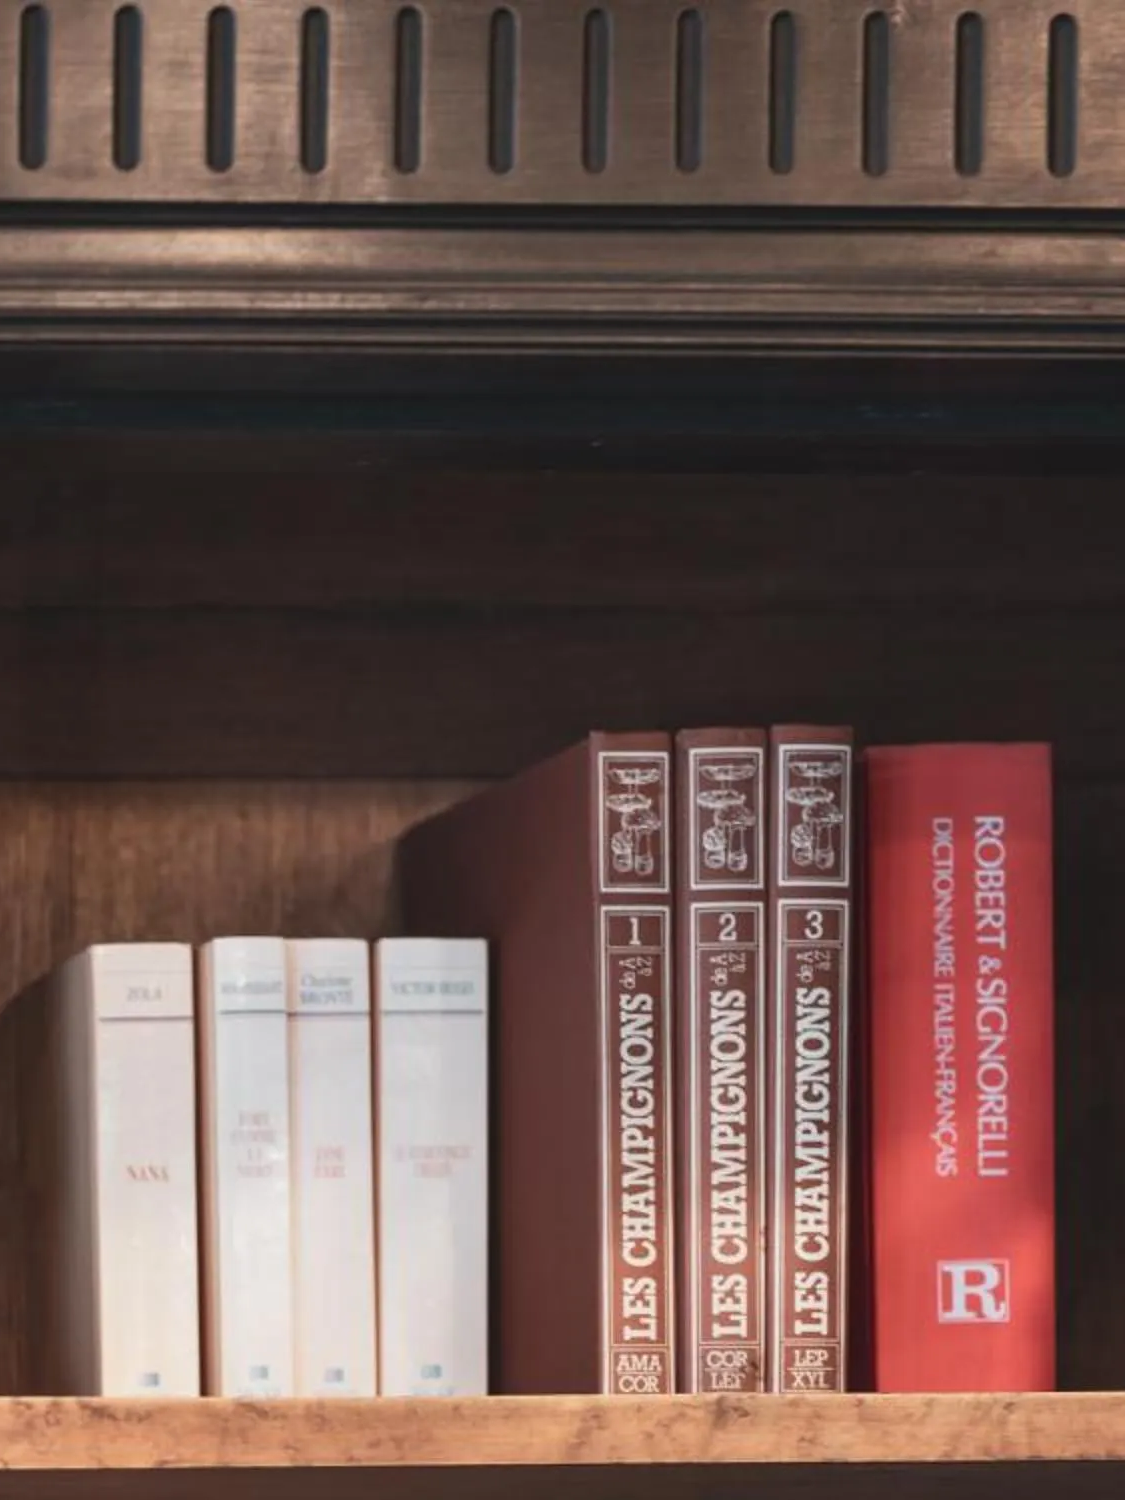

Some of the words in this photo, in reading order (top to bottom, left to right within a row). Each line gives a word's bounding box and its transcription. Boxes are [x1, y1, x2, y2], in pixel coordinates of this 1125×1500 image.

[932, 817, 955, 977] DICTIONNAIRE
[974, 815, 1006, 950] ROBERT
[629, 917, 641, 945] 1
[718, 913, 737, 941] 2
[804, 910, 824, 939] 3
[978, 955, 1002, 974] &
[930, 983, 958, 1177] ITALIEN-FRANÇAIS
[976, 978, 1009, 1177] SIGNORELLI
[619, 993, 657, 1267] CHAMPIGNONS
[709, 989, 748, 1265] CHAMPIGNONS
[794, 987, 831, 1262] CHAMPIGNONS
[622, 1277, 657, 1341] LES
[712, 1273, 747, 1338] LES
[794, 1271, 829, 1335] LES
[940, 1262, 1007, 1320] R
[616, 1354, 662, 1371] AMA
[618, 1375, 660, 1393] COR
[706, 1350, 748, 1368] COR
[791, 1371, 828, 1388] XYL
[793, 1350, 828, 1367] LEP
